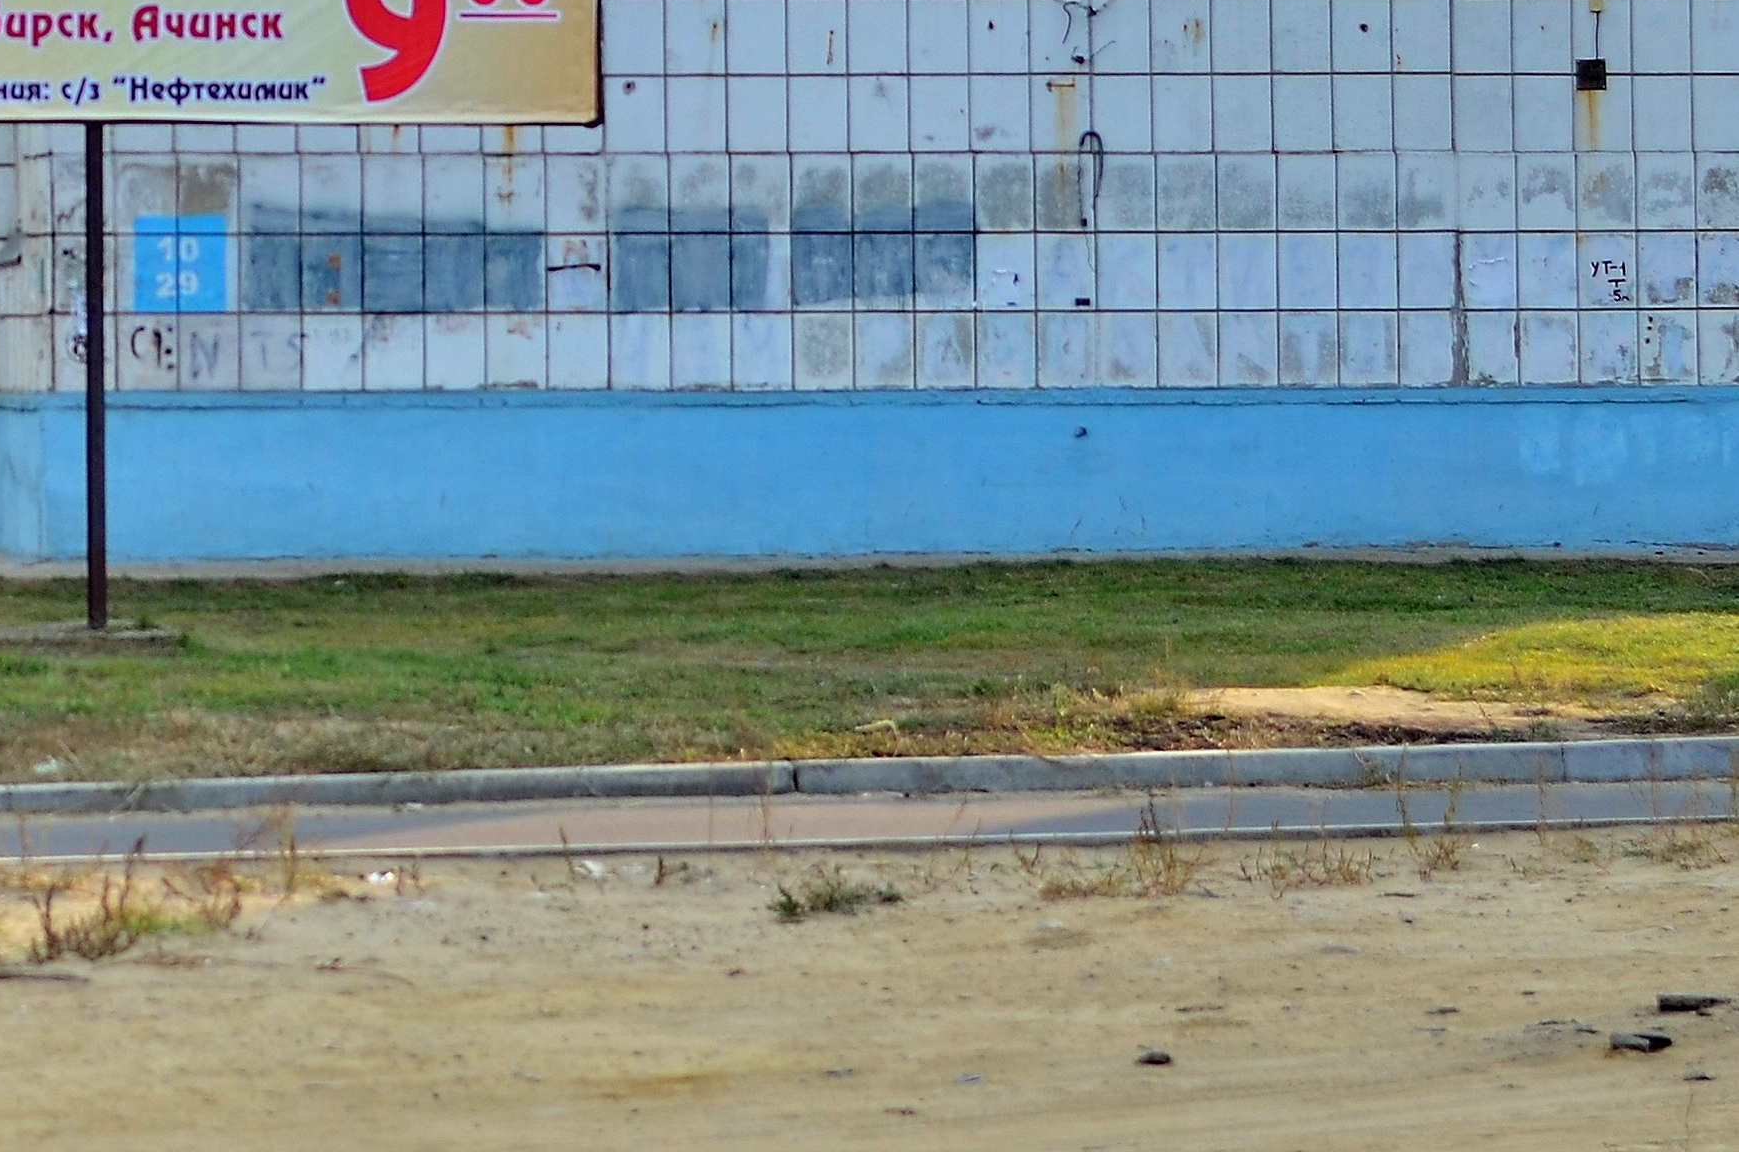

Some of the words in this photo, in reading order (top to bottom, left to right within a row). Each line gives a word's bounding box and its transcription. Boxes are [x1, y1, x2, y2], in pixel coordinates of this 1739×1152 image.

[132, 4, 283, 42] Ачинск
[61, 77, 100, 106] с/з
[157, 234, 202, 263] 10
[155, 269, 202, 299] 29
